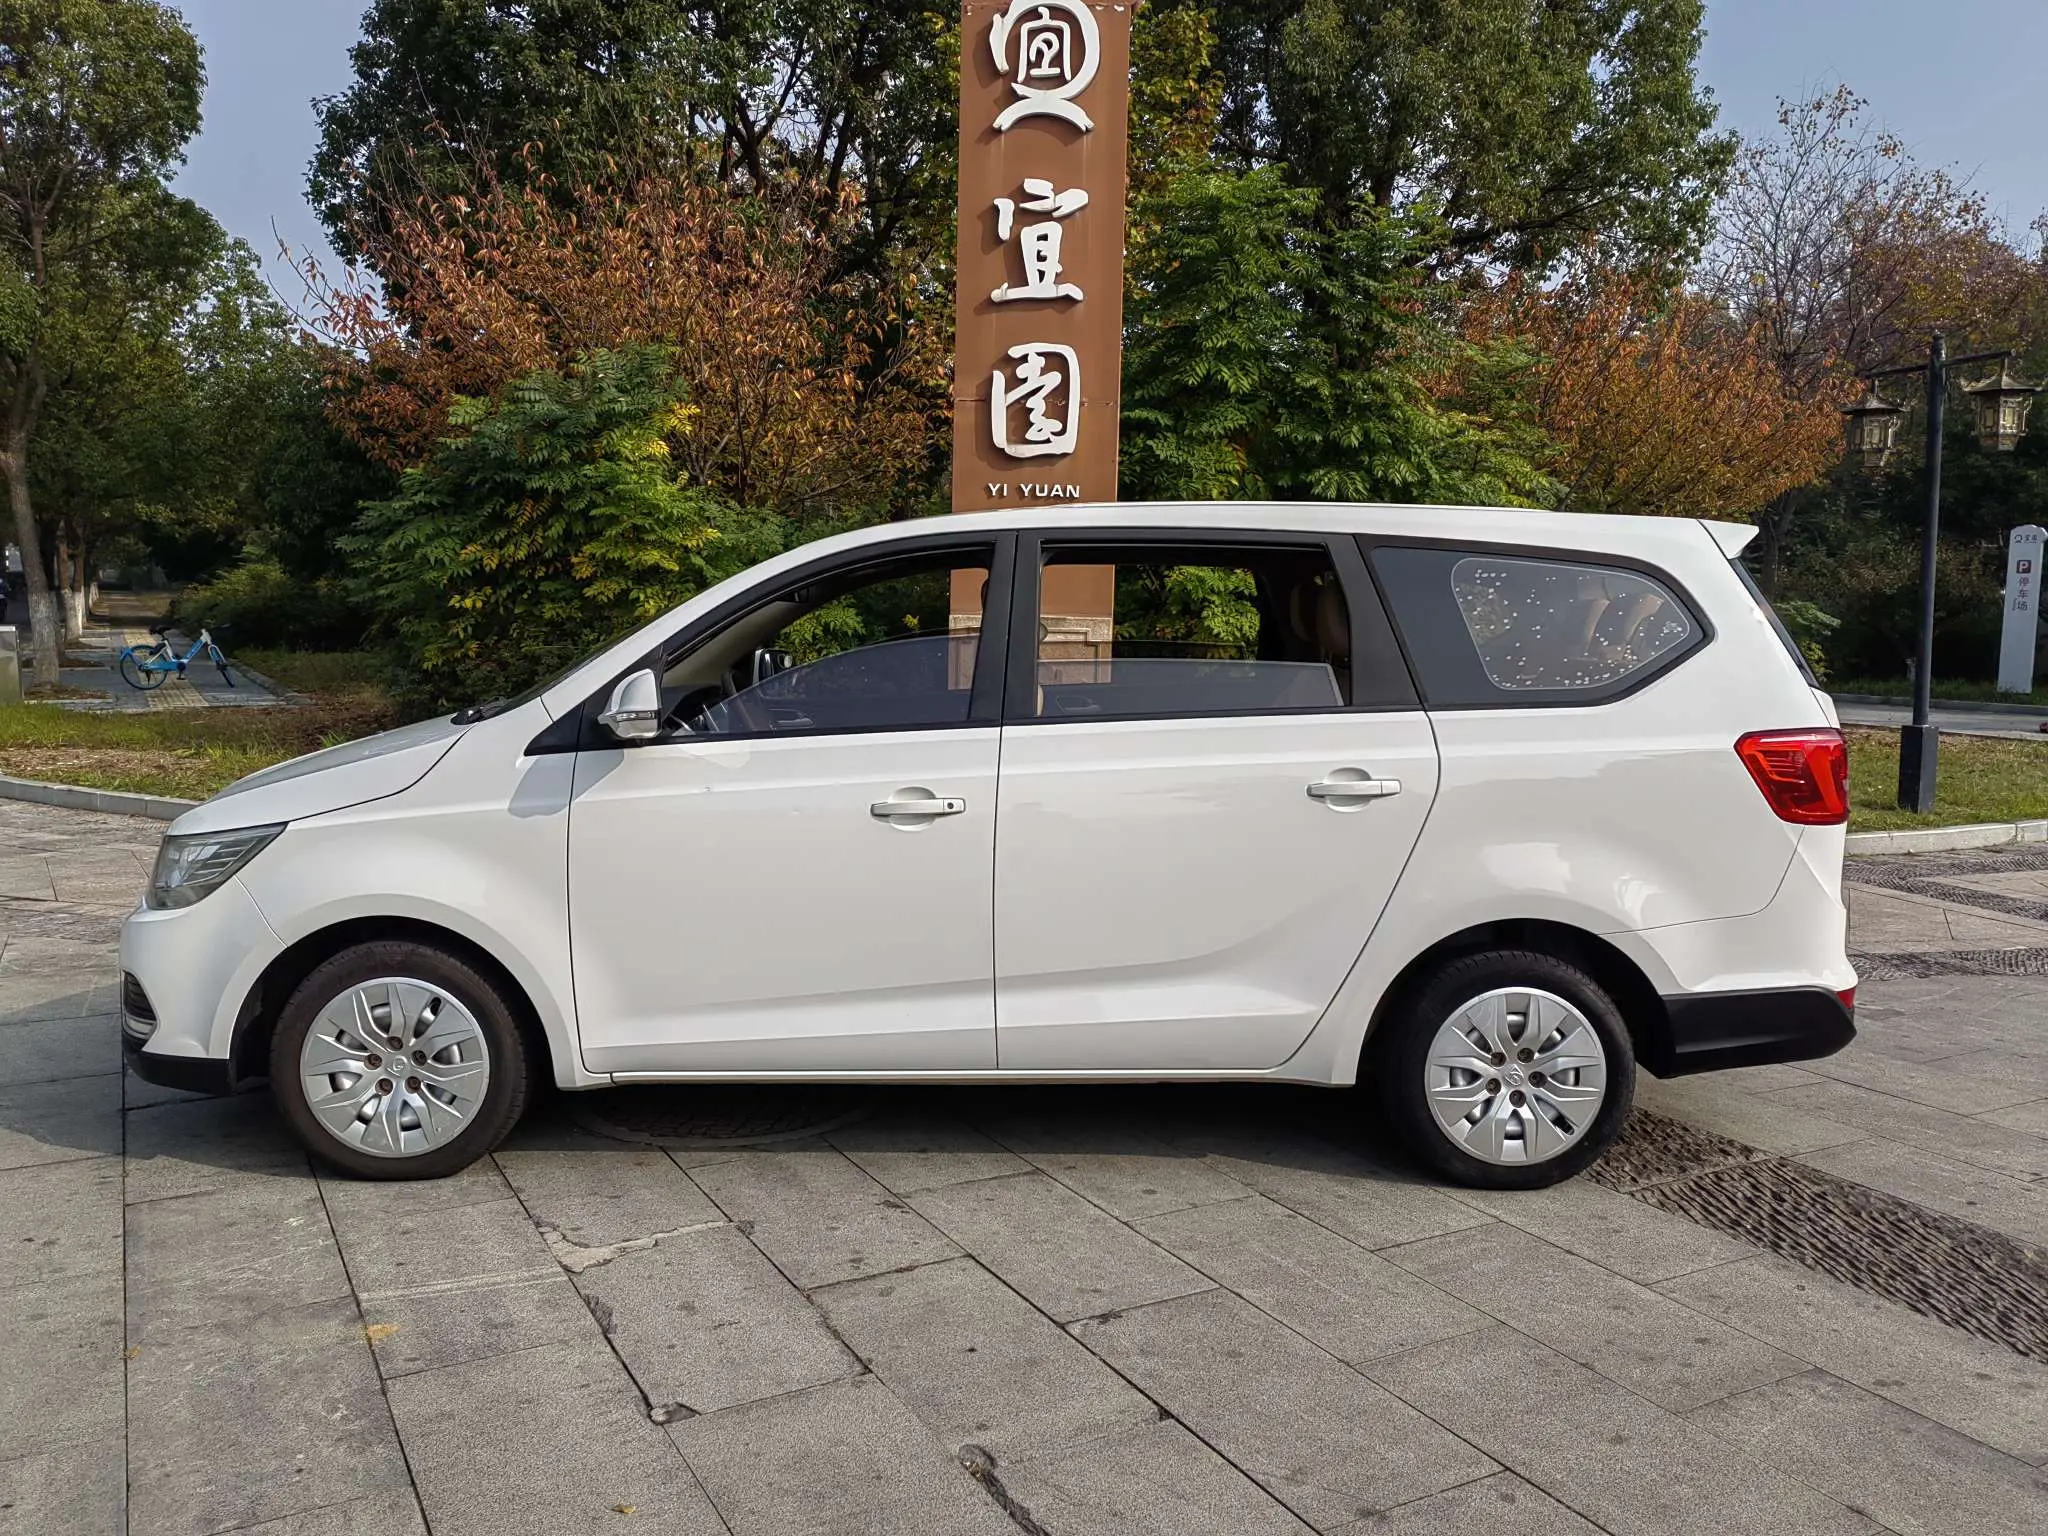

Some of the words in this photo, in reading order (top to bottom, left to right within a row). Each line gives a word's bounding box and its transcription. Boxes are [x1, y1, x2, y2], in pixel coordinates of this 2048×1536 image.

[988, 483, 1008, 497] YI
[1020, 483, 1081, 498] YUAN
[2019, 560, 2029, 573] P
[2016, 576, 2030, 611] 停车场
